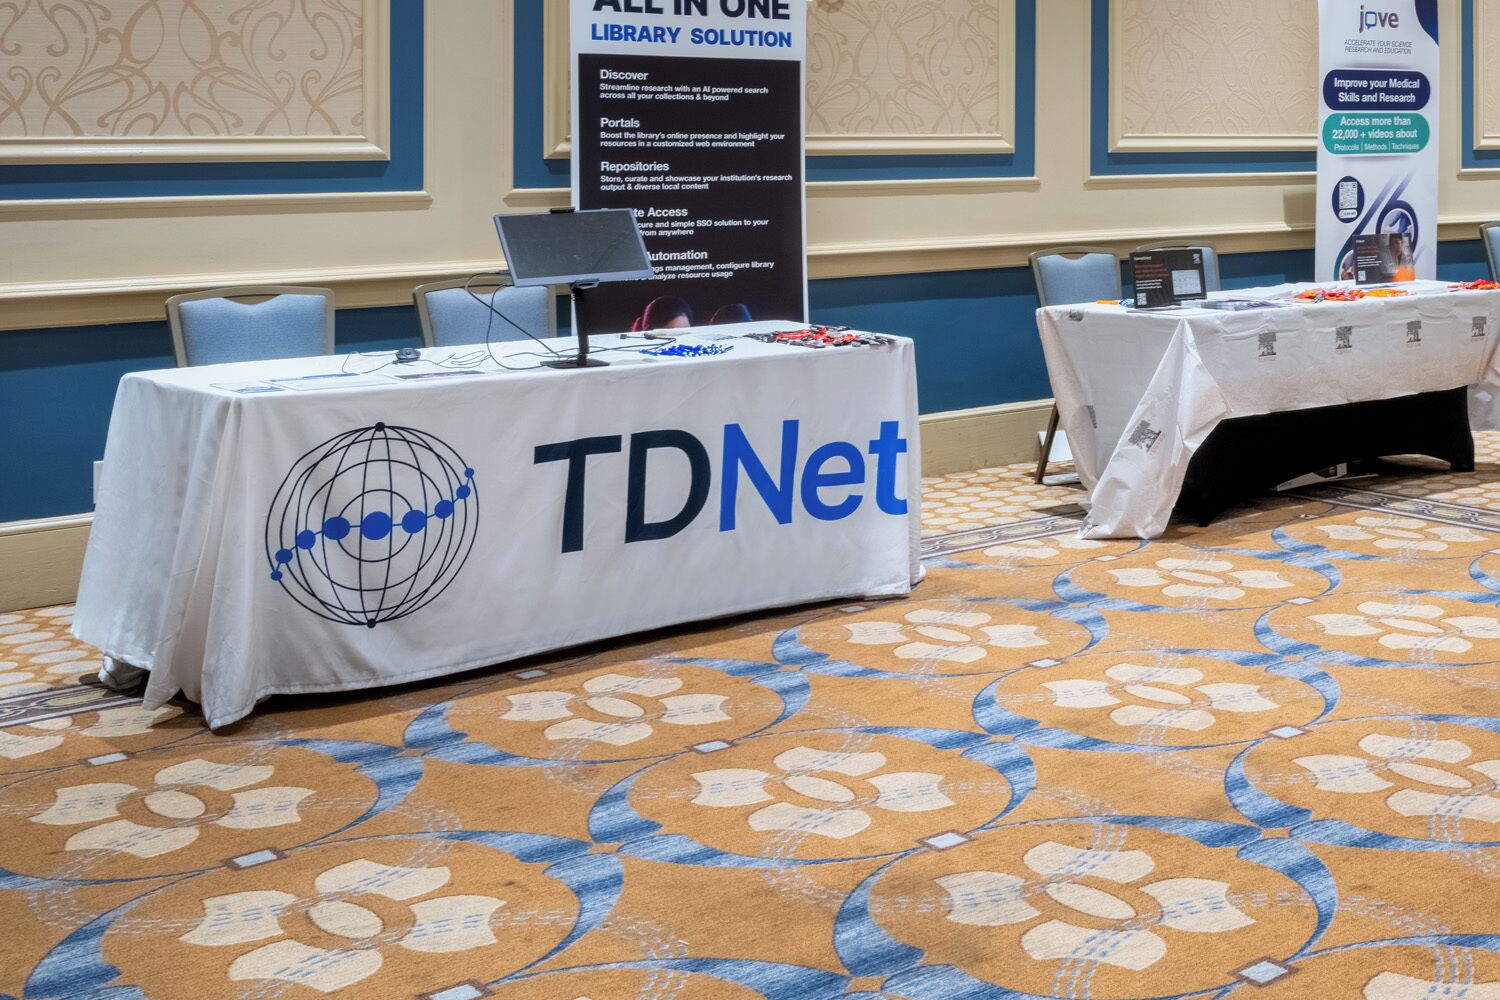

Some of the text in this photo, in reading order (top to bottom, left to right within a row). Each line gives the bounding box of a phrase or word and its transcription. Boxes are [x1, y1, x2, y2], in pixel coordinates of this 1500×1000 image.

[1358, 4, 1399, 33] jove
[591, 23, 792, 48] LIBRARY SOLUTION
[1344, 39, 1376, 47] ACCELERATE
[600, 69, 649, 80] Discover
[600, 83, 640, 91] Streamline
[641, 84, 673, 92] research
[711, 86, 743, 94] powered
[744, 86, 769, 94] search
[1334, 77, 1420, 90] Improve your Medical
[637, 93, 654, 101] your
[655, 92, 695, 100] collections
[702, 93, 729, 102] beyond
[1338, 92, 1416, 103] Skills and Research
[600, 117, 641, 128] Portals
[1340, 116, 1412, 126] Access more than
[600, 131, 623, 139] Boost
[624, 131, 636, 139] the
[637, 132, 666, 140] library's
[690, 133, 723, 141] presence
[723, 132, 737, 140] and
[738, 132, 769, 141] highlight
[769, 133, 785, 141] your
[1332, 129, 1359, 140] 22,000
[1368, 129, 1394, 139] videos
[1395, 129, 1418, 138] about
[638, 139, 645, 147] in
[711, 140, 755, 148] environment
[1334, 142, 1419, 151] Protocols Methods Techniques
[600, 161, 670, 174] Repositories
[600, 175, 624, 183] Store,
[702, 175, 719, 183] your
[720, 174, 762, 182] institution's
[762, 173, 793, 181] research
[600, 183, 626, 192] output
[626, 183, 633, 191] &
[647, 207, 689, 217] Access
[637, 221, 654, 229] cure
[655, 220, 669, 228] and
[670, 220, 696, 229] simple
[696, 219, 713, 227] SSO
[713, 219, 743, 227] solution
[752, 219, 769, 227] your
[658, 229, 694, 237] anywhere
[665, 263, 715, 272] management,
[715, 262, 750, 270] configure
[751, 261, 775, 269] library
[650, 272, 676, 281] nalyze
[677, 271, 710, 279] resource
[711, 270, 734, 278] usage
[533, 418, 910, 553] TDNet
